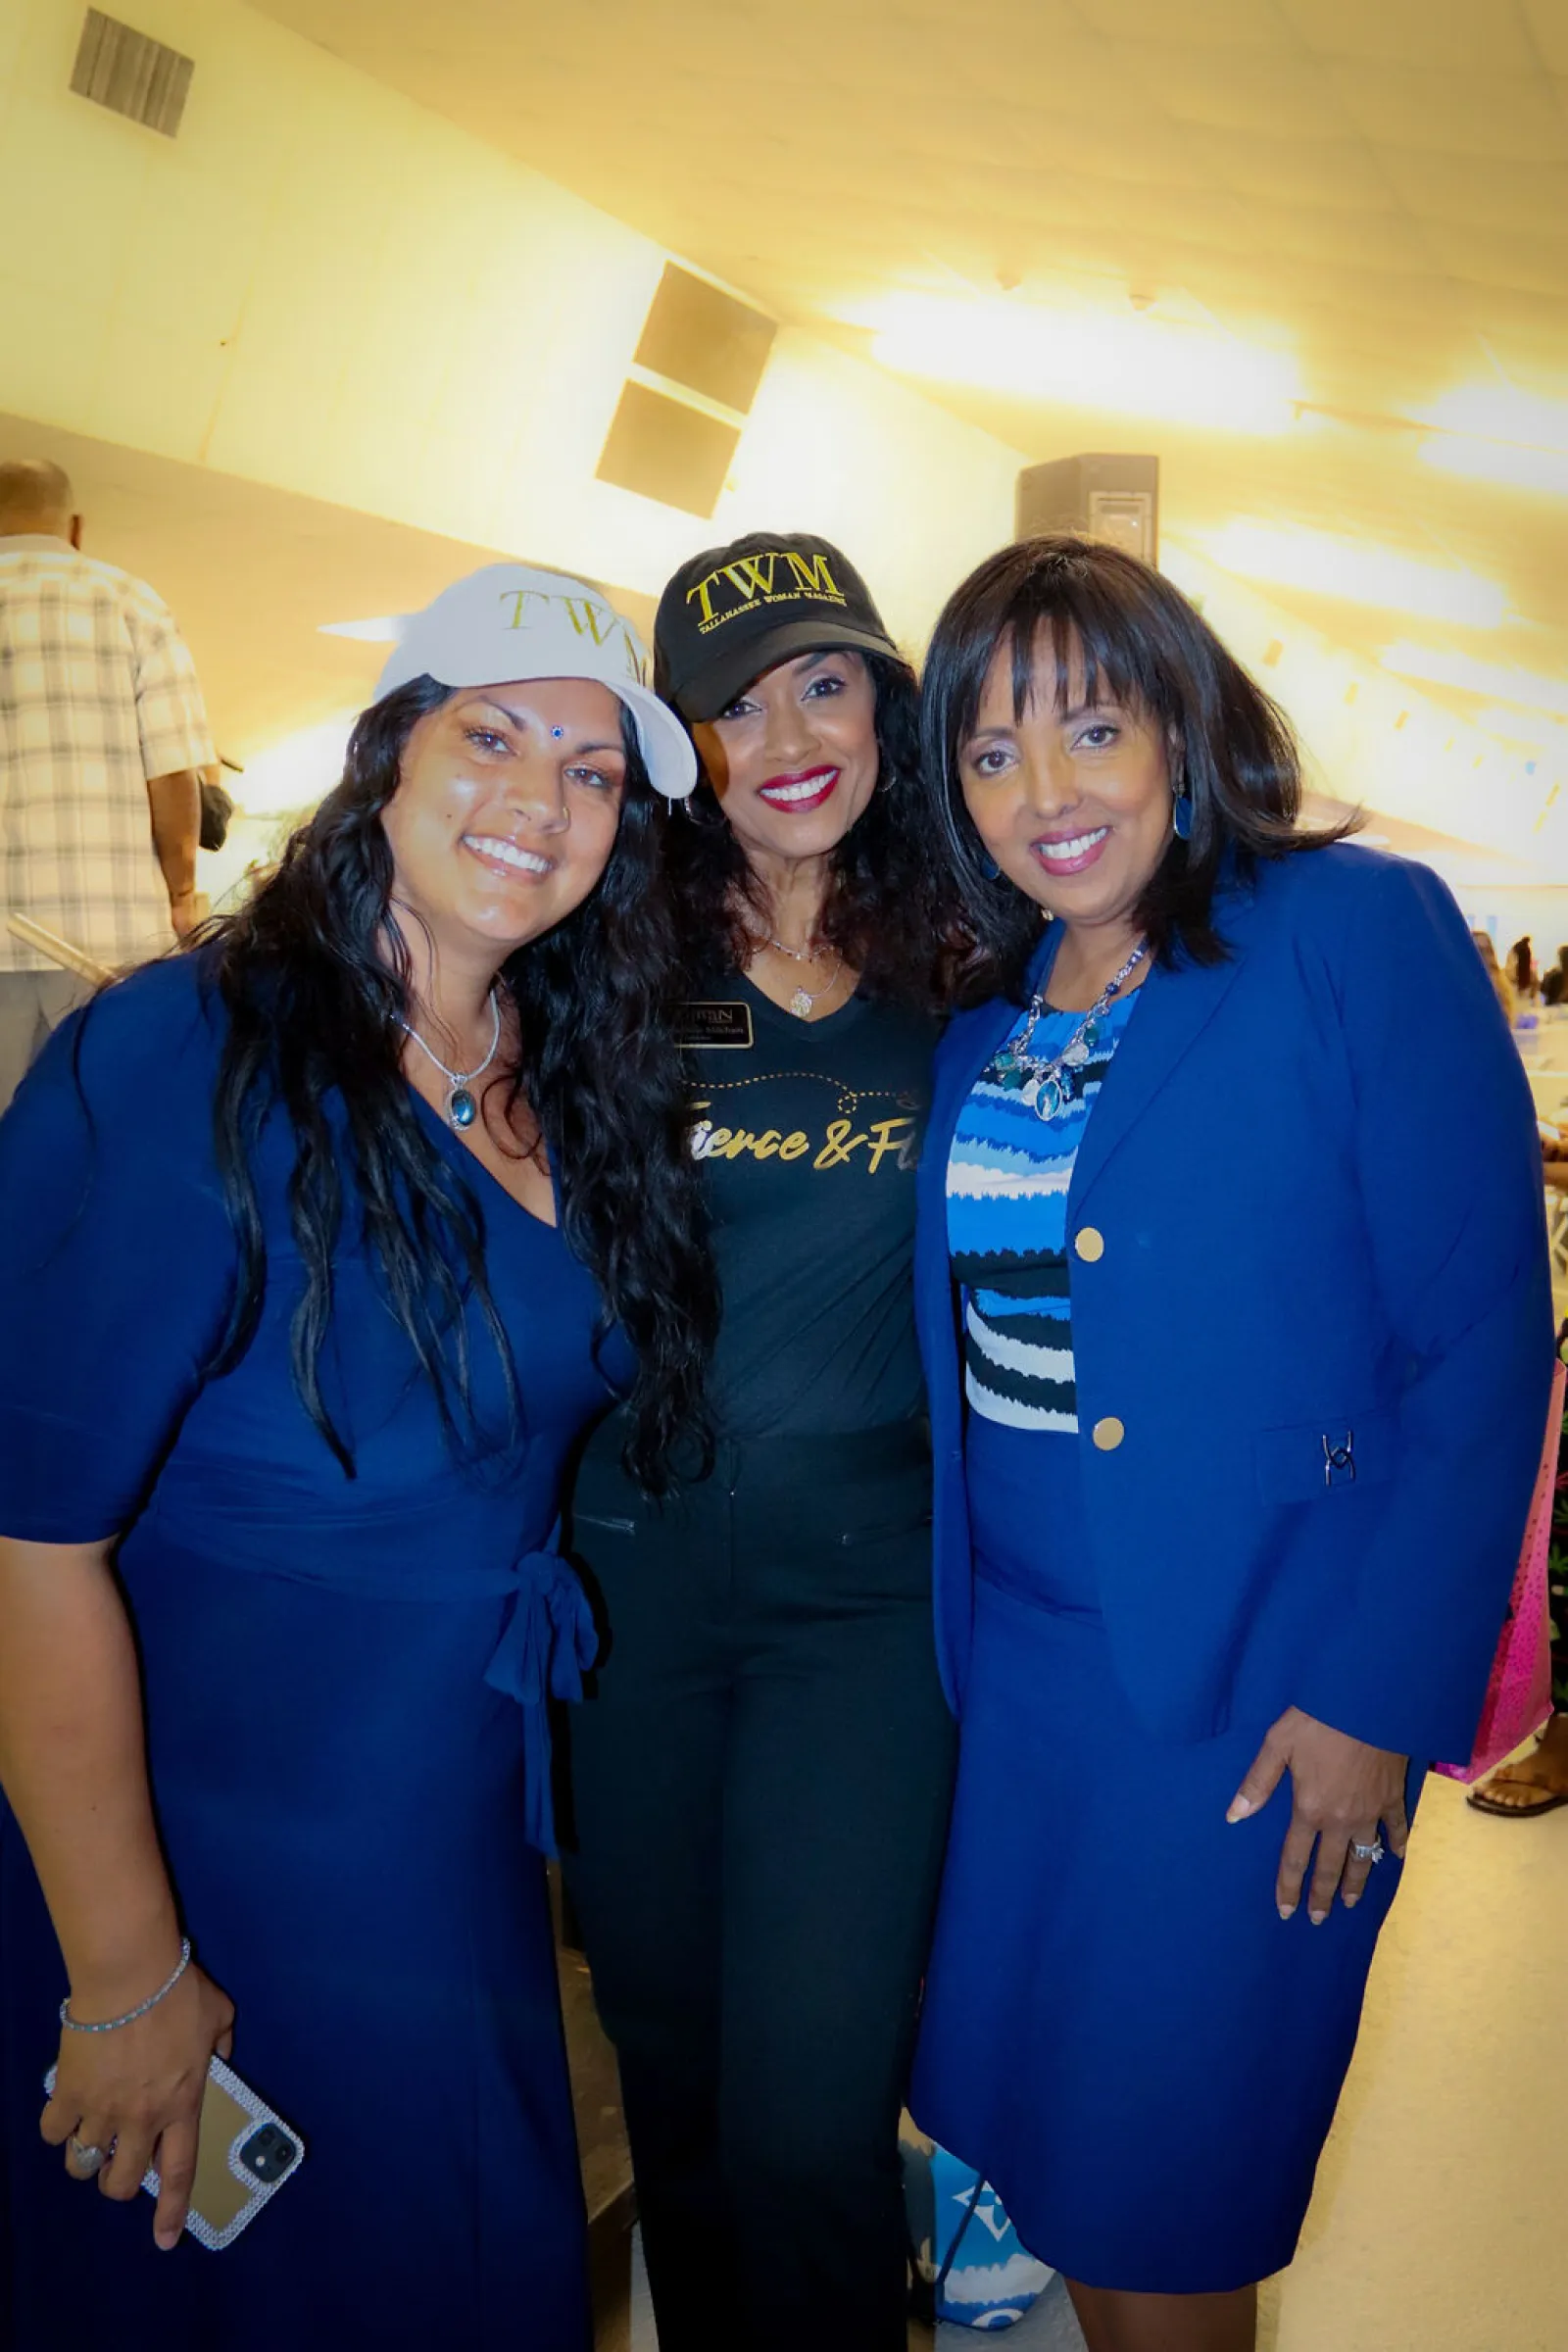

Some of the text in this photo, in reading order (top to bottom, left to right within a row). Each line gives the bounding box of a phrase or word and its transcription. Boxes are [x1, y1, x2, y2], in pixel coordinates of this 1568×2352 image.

[686, 552, 845, 627] TWM
[699, 592, 848, 635] TALLAHASSEE WOMAN MAGAZINE
[812, 1118, 869, 1171] &
